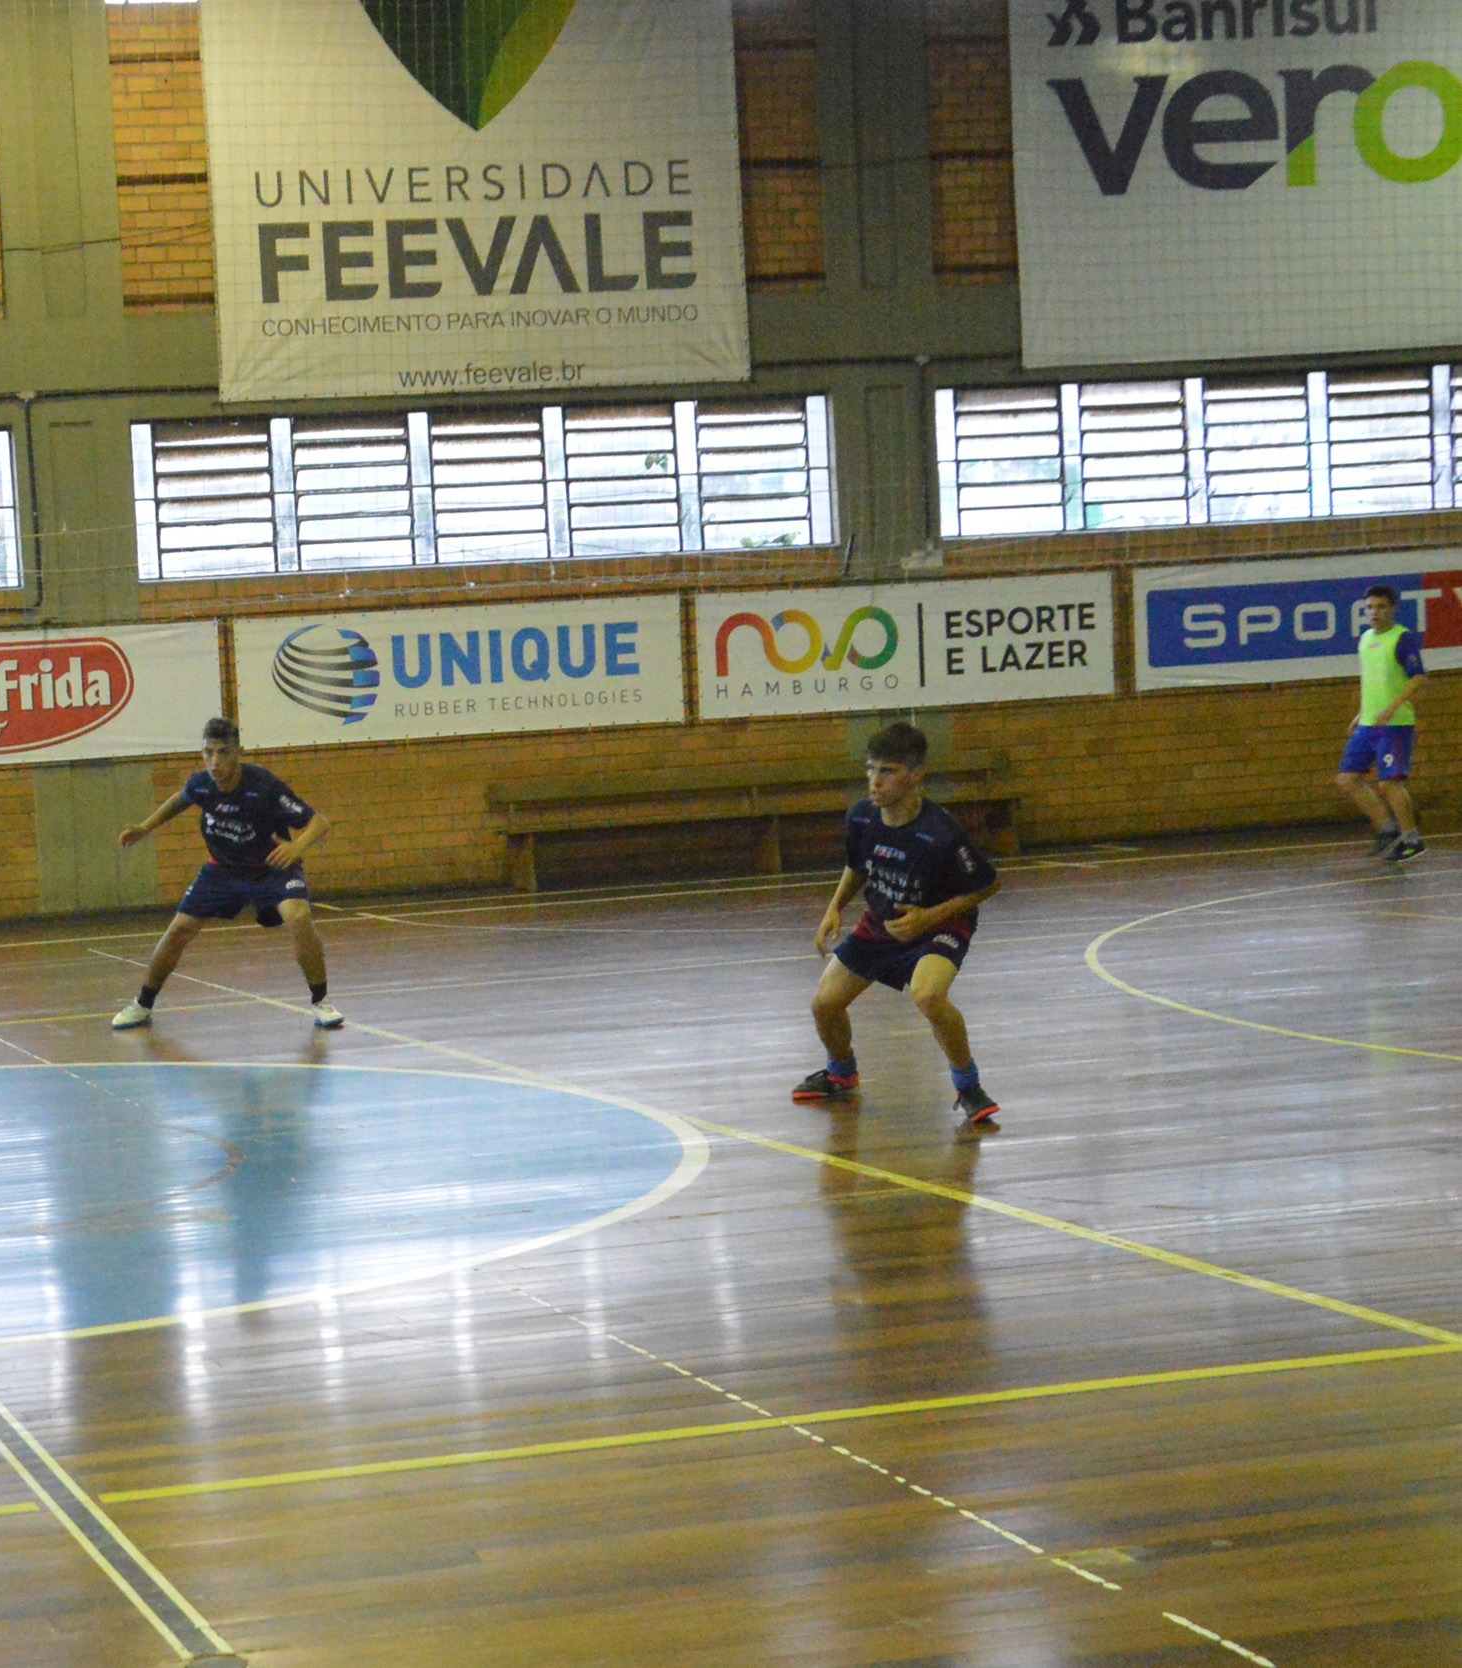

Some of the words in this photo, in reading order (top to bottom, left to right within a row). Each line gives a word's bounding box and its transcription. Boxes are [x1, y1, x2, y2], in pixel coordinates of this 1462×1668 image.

[254, 159, 692, 207] UNIVERSIDADE
[258, 211, 697, 304] FEEVALE
[262, 312, 441, 337] CONHECIMENTO
[447, 312, 504, 330] PARA
[511, 308, 590, 328] INOVAR
[595, 307, 612, 325] O
[618, 304, 698, 324] MUNDO
[398, 361, 585, 388] www.feevale.br
[945, 602, 1096, 640] ESPORTE
[391, 621, 641, 689] UNIQUE
[947, 648, 965, 675] E
[982, 640, 1089, 673] LAZER
[395, 698, 477, 717] RUBBER
[490, 688, 643, 711] TECHNOLOGIES
[716, 674, 899, 699] HAMBURGO
[1382, 753, 1394, 768] 9
